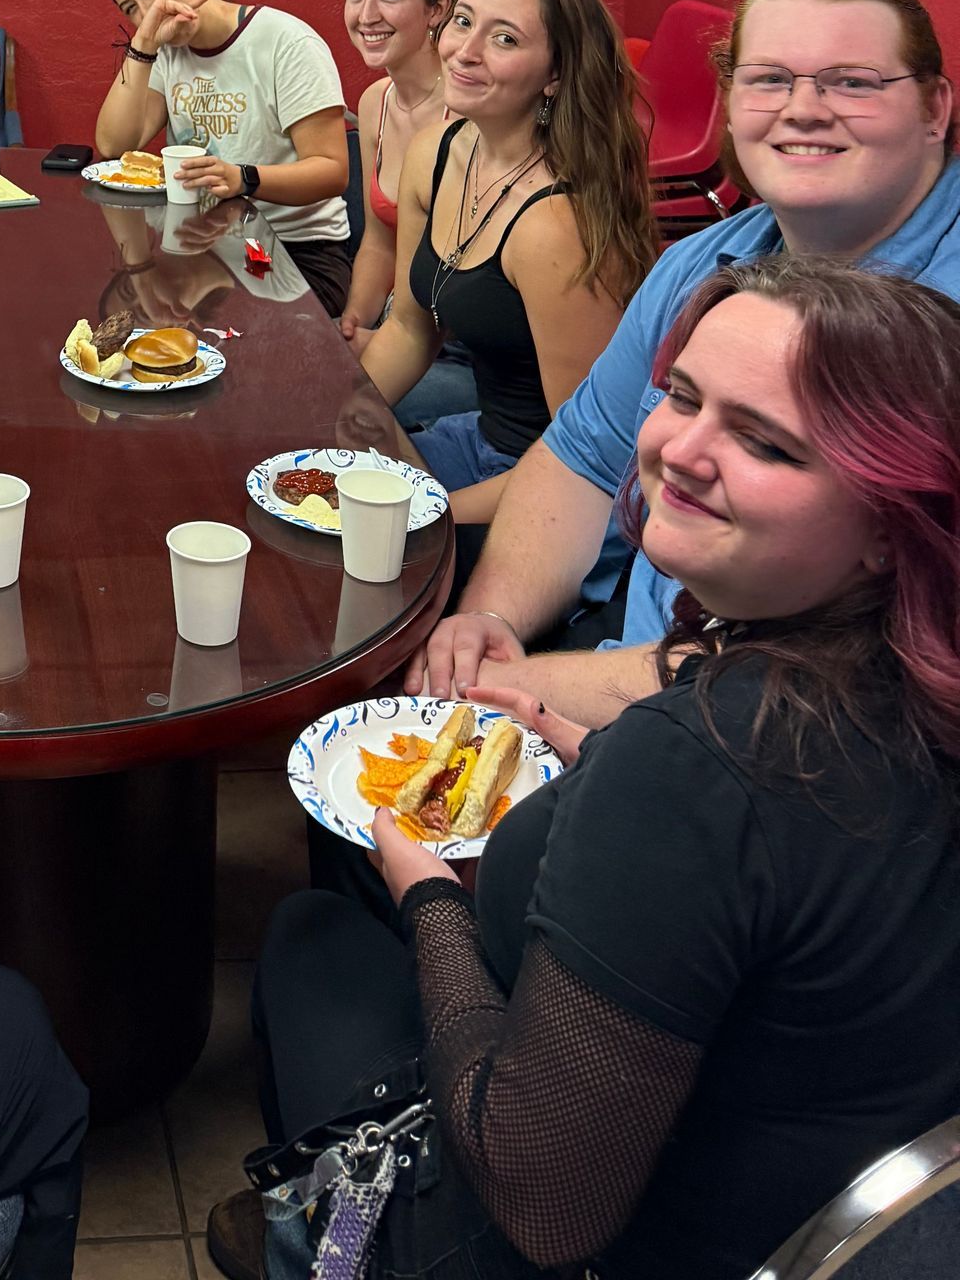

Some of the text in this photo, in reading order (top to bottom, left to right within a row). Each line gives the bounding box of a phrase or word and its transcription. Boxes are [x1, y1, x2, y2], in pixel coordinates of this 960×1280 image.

[172, 83, 246, 115] PRINCESS
[193, 76, 216, 93] THE
[193, 115, 238, 148] BRIDE
